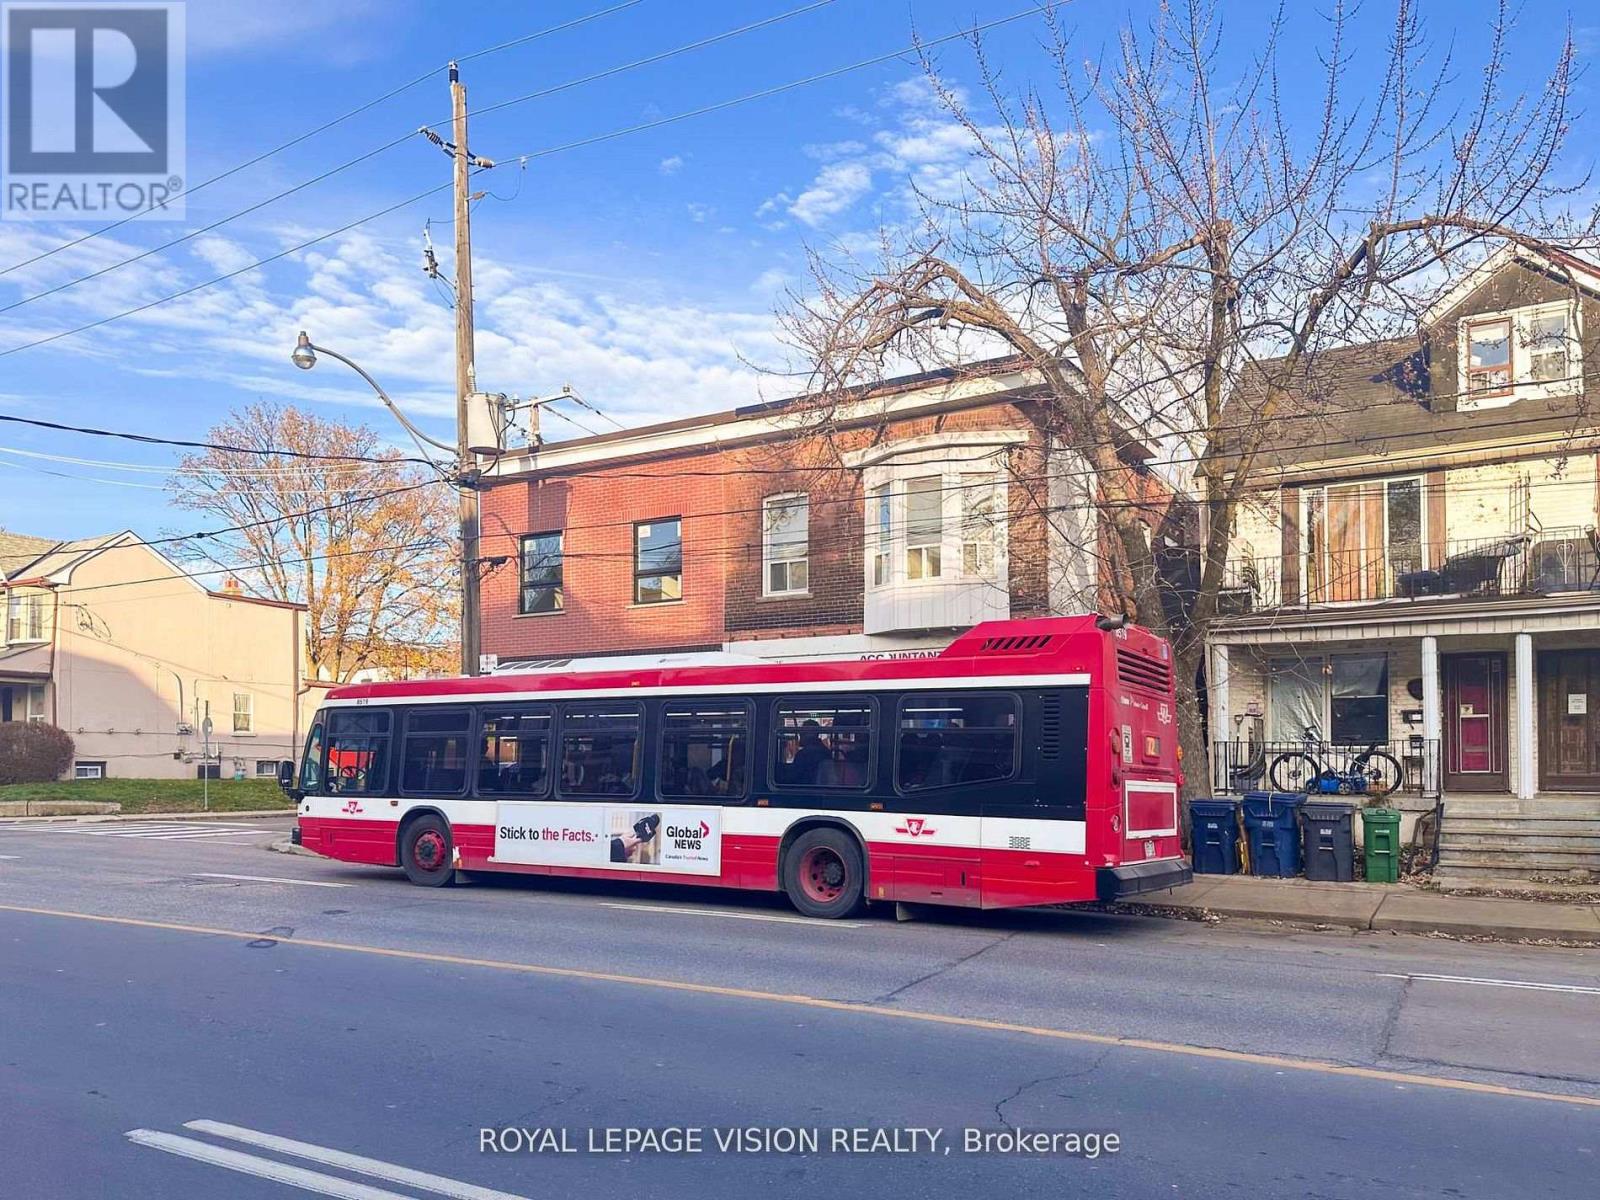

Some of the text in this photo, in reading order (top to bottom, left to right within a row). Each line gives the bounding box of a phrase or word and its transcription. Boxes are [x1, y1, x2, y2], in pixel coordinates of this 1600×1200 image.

[500, 826, 595, 842] Stick to the Facts.
[666, 826, 702, 839] Global
[674, 839, 702, 850] NEWS
